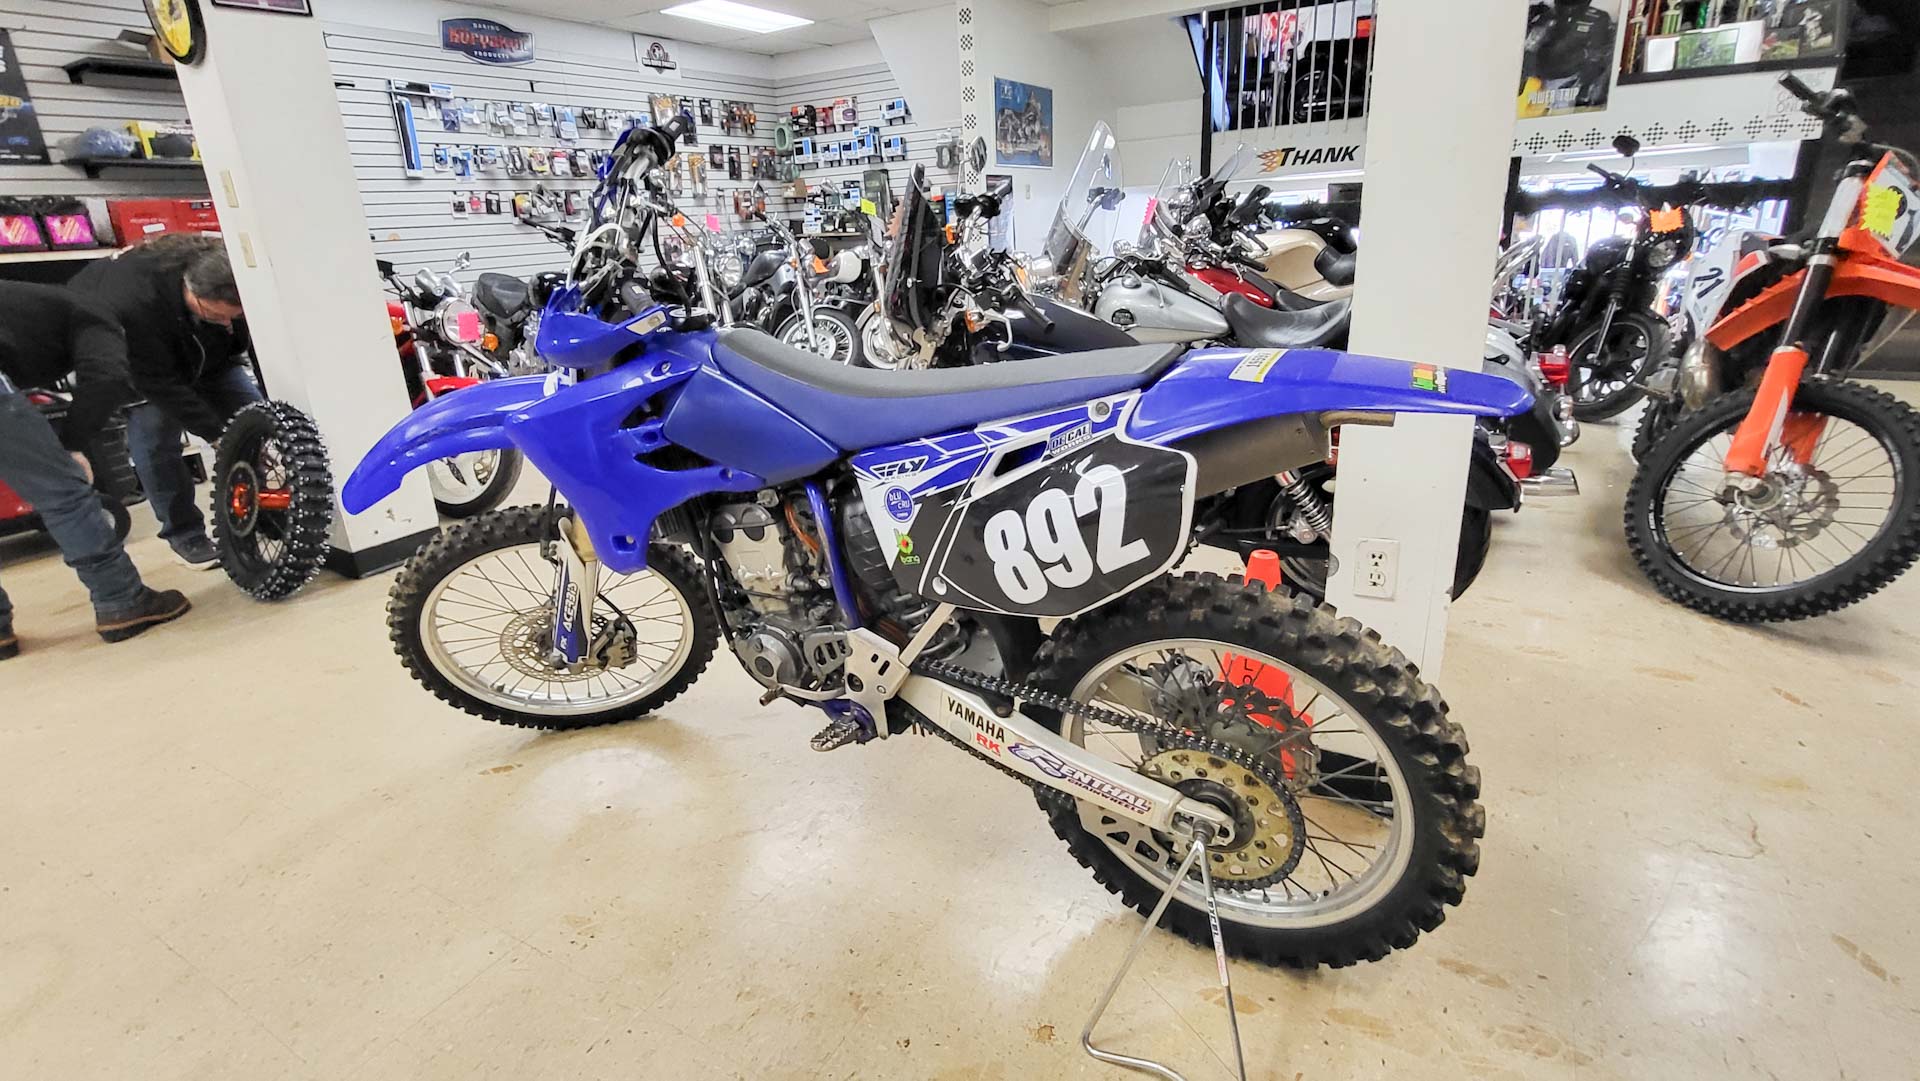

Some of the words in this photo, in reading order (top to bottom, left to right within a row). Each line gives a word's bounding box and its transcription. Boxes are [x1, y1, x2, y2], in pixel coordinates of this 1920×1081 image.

[473, 50, 509, 60] PRODUCTS
[1280, 145, 1361, 167] THANK
[1691, 267, 1725, 299] 21
[872, 457, 926, 477] FLY
[983, 464, 1151, 605] 892
[947, 695, 1005, 744] YAMAHA
[976, 732, 1001, 757] RK
[1007, 742, 1152, 812] RENTHAL
[1066, 777, 1146, 816] CHAINWHEELS
